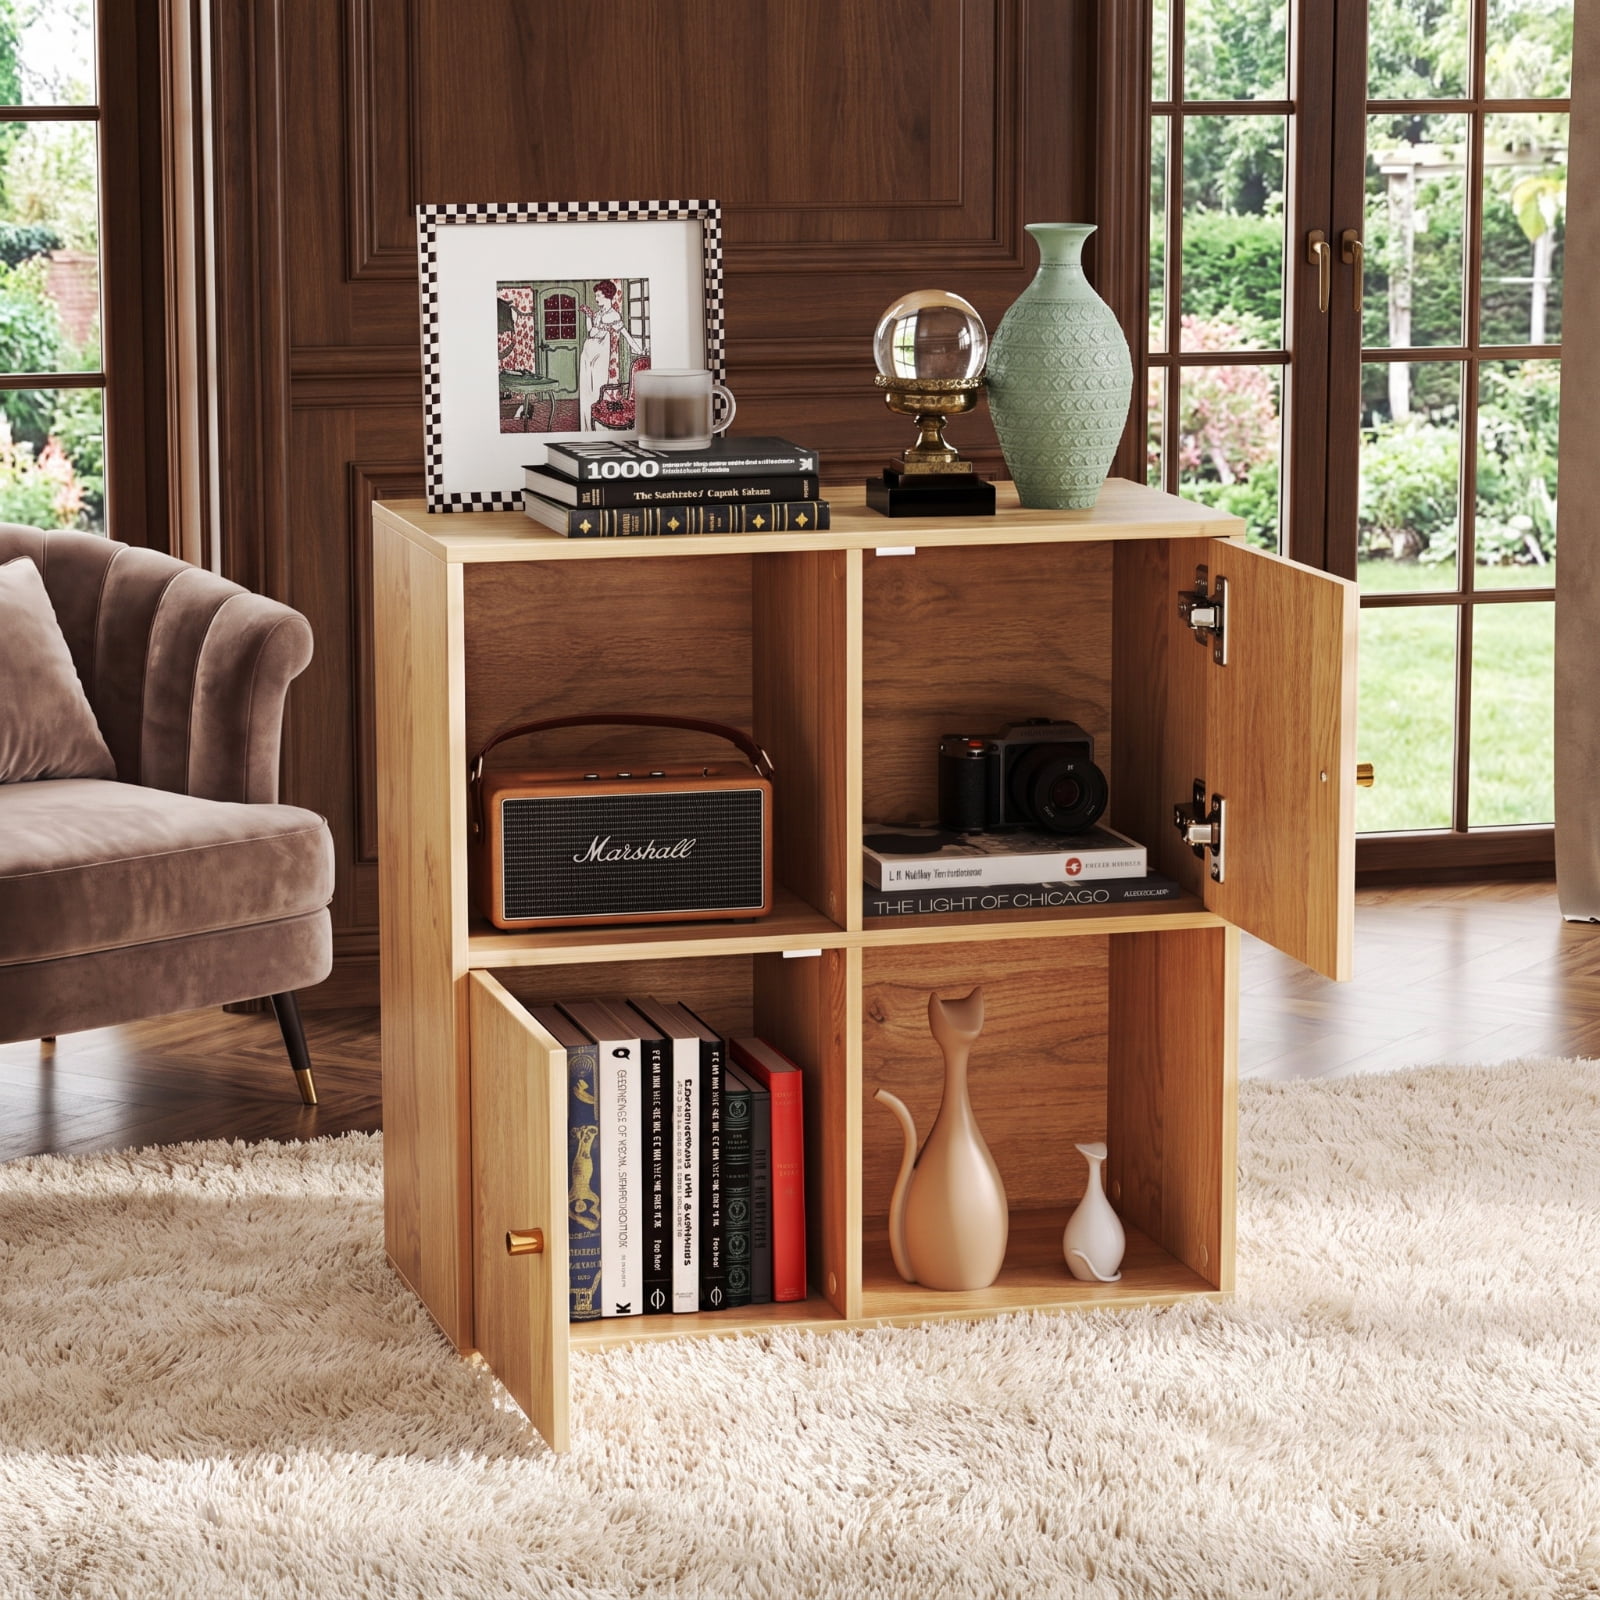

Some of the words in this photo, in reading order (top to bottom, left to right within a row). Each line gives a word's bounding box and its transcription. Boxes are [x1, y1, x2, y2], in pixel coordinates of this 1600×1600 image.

[587, 460, 659, 479] 1000
[633, 491, 653, 501] The
[573, 835, 696, 862] Marshall
[873, 900, 914, 915] THE
[918, 896, 978, 913] LIGHT
[980, 894, 1010, 909] OF
[1013, 889, 1110, 908] CHICAGO
